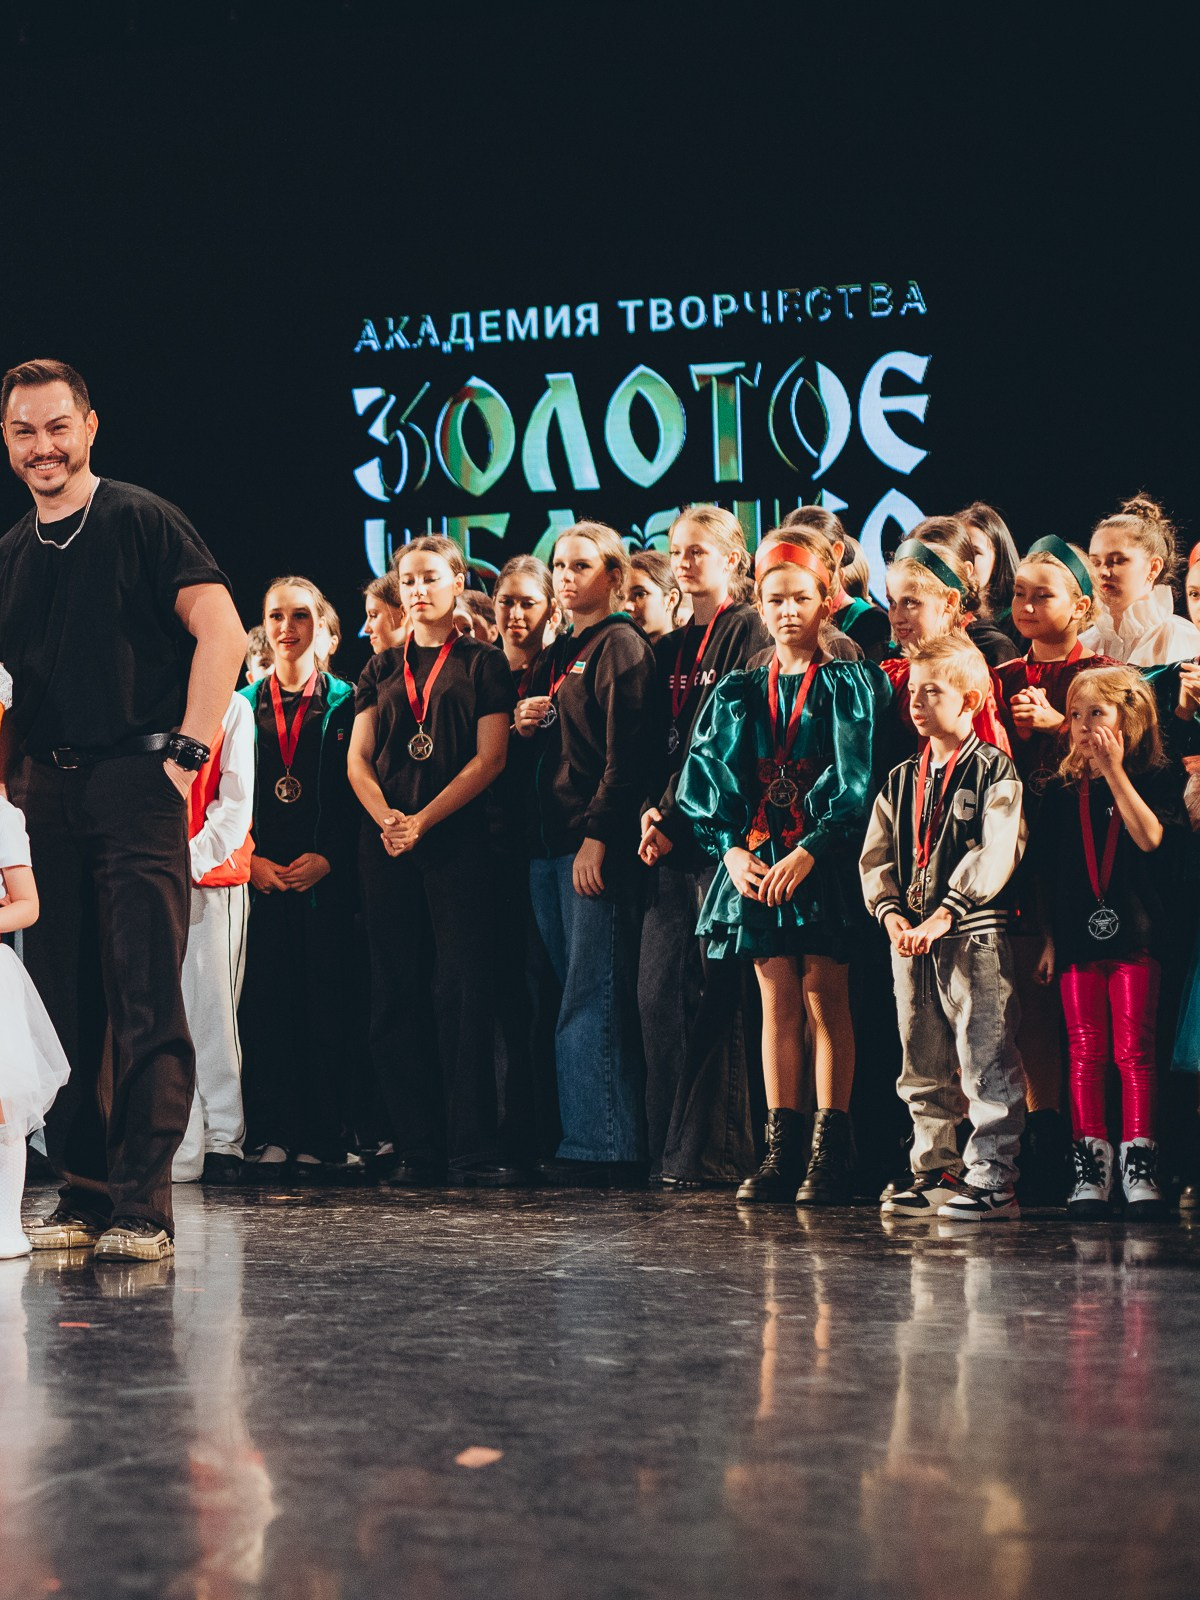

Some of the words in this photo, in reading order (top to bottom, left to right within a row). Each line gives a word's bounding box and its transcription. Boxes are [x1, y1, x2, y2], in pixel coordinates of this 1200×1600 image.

[352, 302, 600, 353] АКАДЕМИЯ
[618, 279, 928, 334] ТВОРЧЕСТВА
[352, 350, 933, 502] ЗОЛОТОЕ
